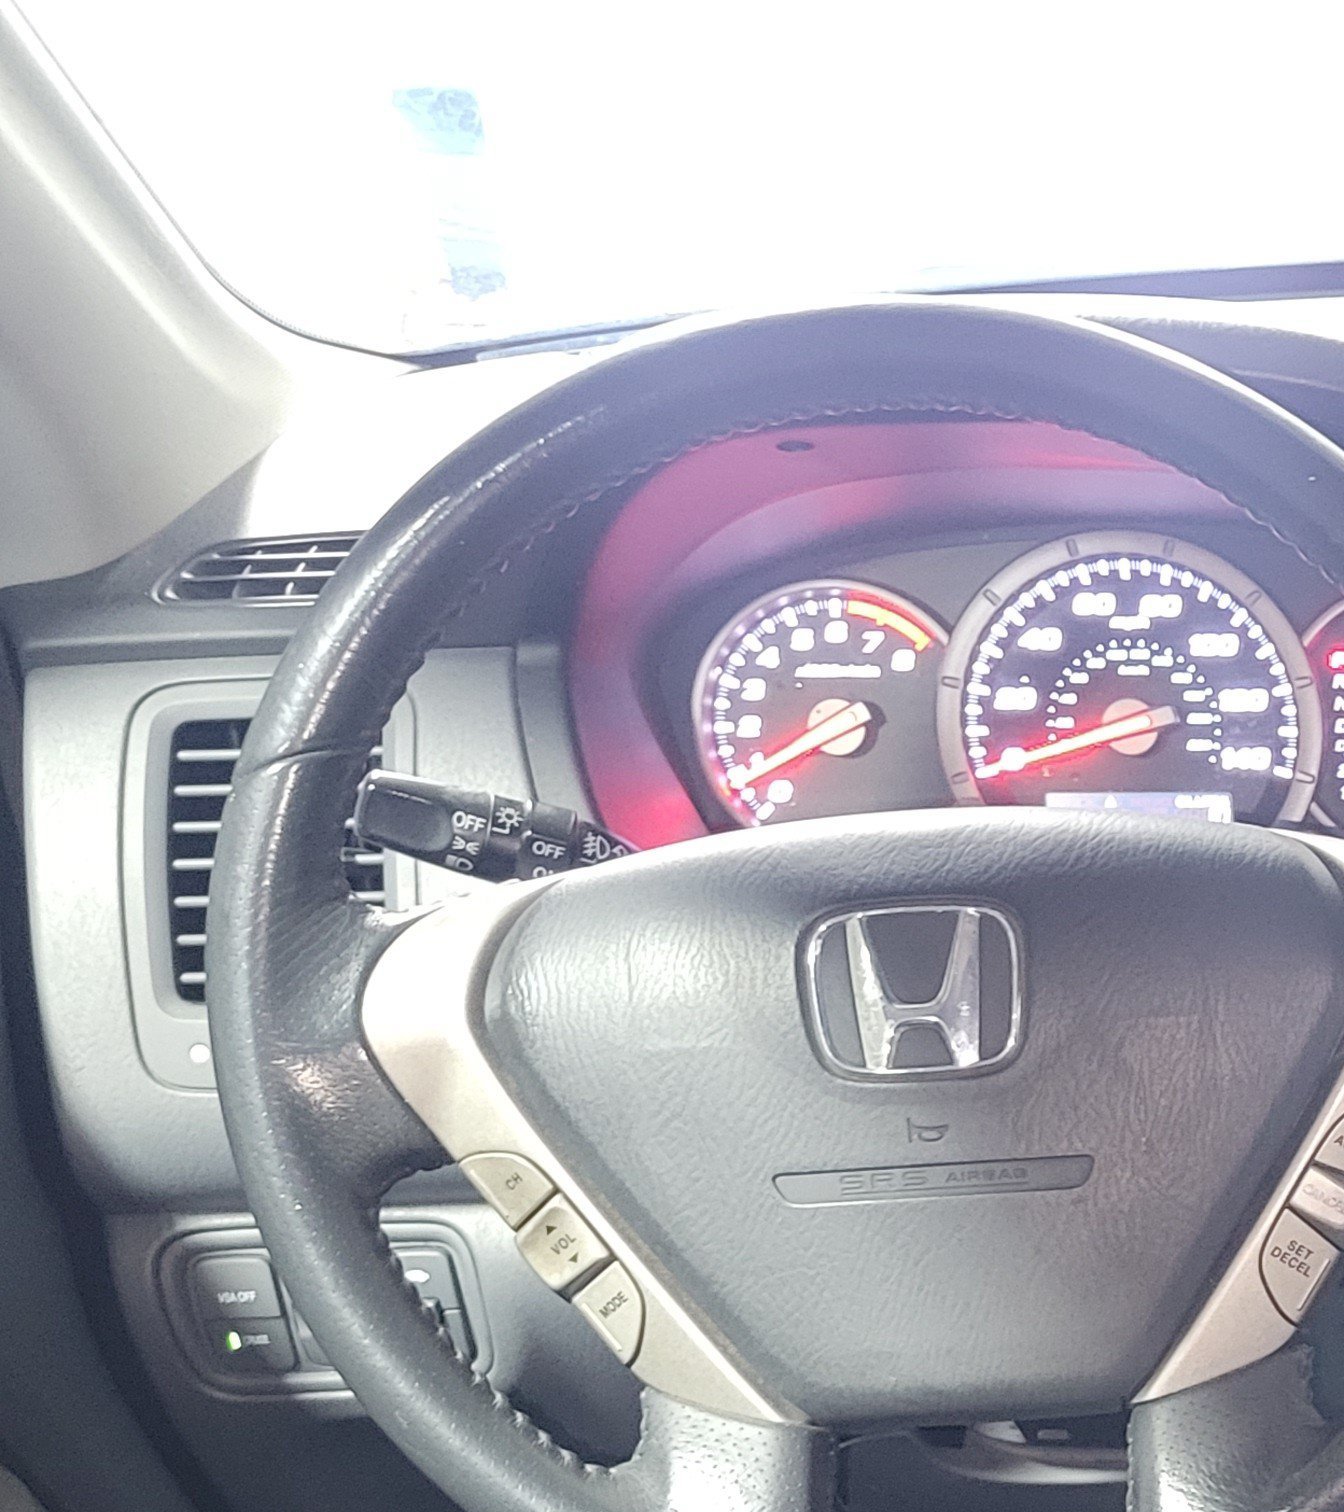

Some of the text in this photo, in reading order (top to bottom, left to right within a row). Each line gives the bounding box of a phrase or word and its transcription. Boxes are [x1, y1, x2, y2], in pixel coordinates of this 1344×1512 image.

[861, 631, 885, 653] 7
[451, 810, 487, 833] OFF
[531, 840, 567, 860] OFF
[506, 1172, 524, 1190] CH
[839, 1167, 1029, 1190] SRS AIRBAG
[550, 1233, 577, 1256] VOL
[1286, 1239, 1315, 1259] SET
[1269, 1245, 1312, 1278] DECEL
[217, 1290, 256, 1304] VSA OFF
[599, 1290, 629, 1319] MODE
